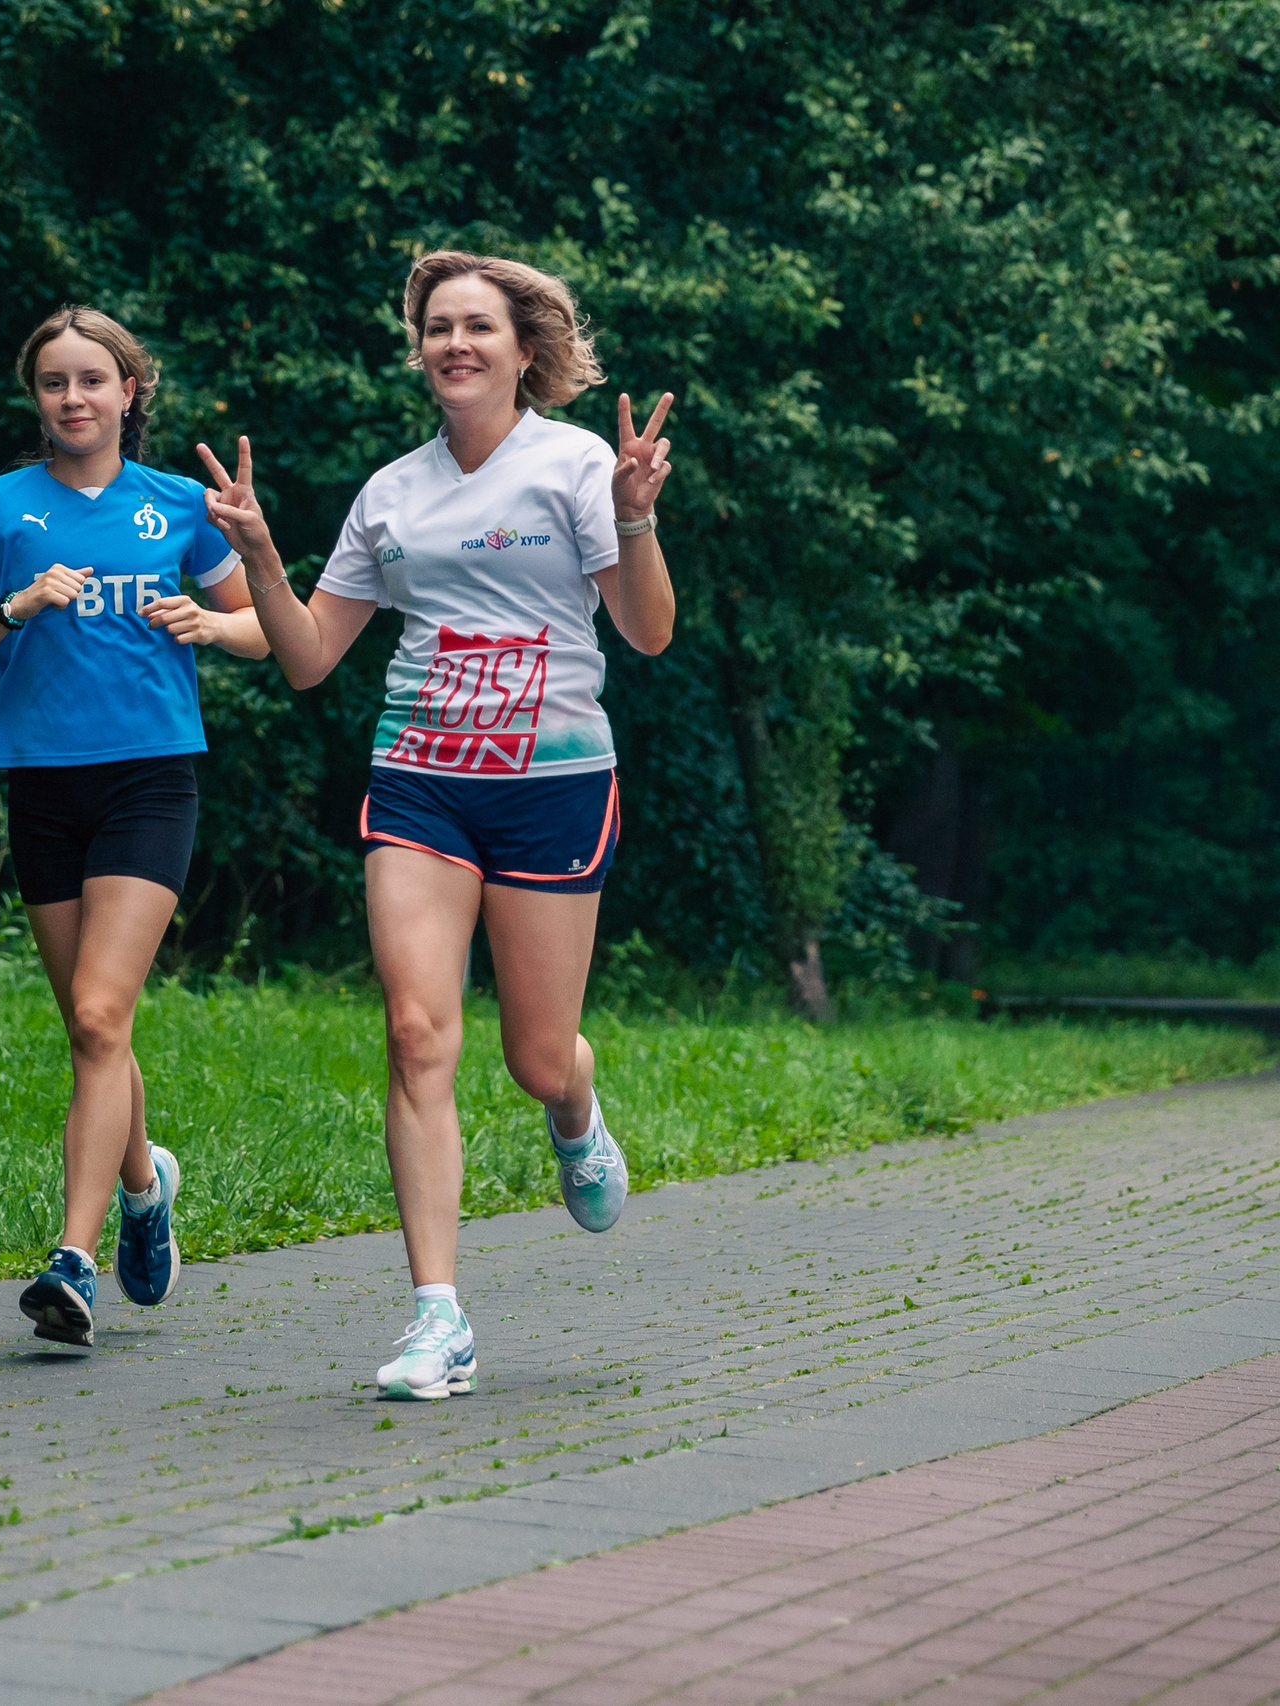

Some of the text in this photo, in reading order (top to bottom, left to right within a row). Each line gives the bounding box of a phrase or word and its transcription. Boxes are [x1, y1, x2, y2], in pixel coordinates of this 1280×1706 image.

[380, 546, 405, 566] ADA
[461, 535, 551, 550] РОЗА ХУТОР
[76, 574, 162, 617] ВТБ
[410, 649, 550, 730] ROSA
[392, 730, 529, 772] RUN
